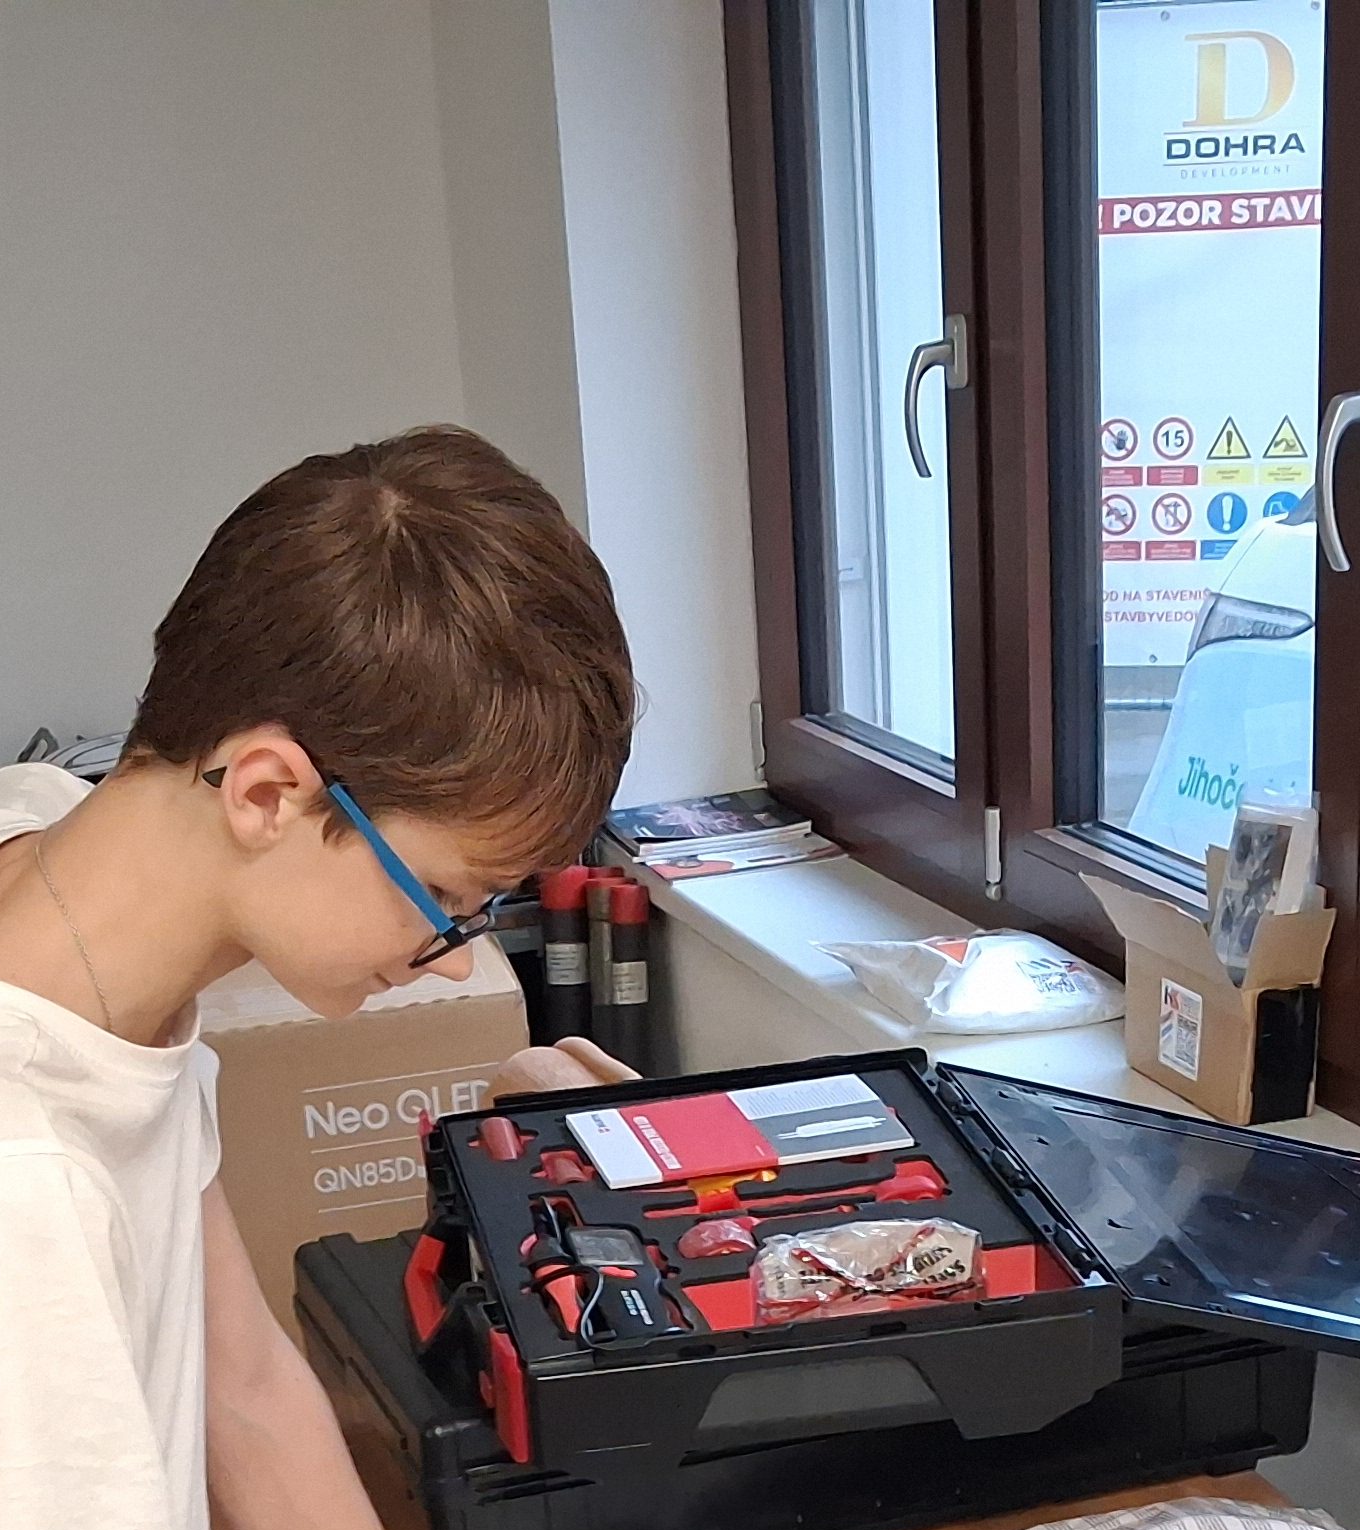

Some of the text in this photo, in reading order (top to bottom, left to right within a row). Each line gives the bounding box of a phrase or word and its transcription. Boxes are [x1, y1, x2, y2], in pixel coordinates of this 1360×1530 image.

[1166, 132, 1306, 160] DOHRA
[1180, 165, 1291, 180] DEVELOPMENT
[1113, 201, 1221, 229] POZOR
[1161, 429, 1185, 448] 15
[1123, 590, 1142, 602] NA
[304, 1101, 389, 1138] Neo
